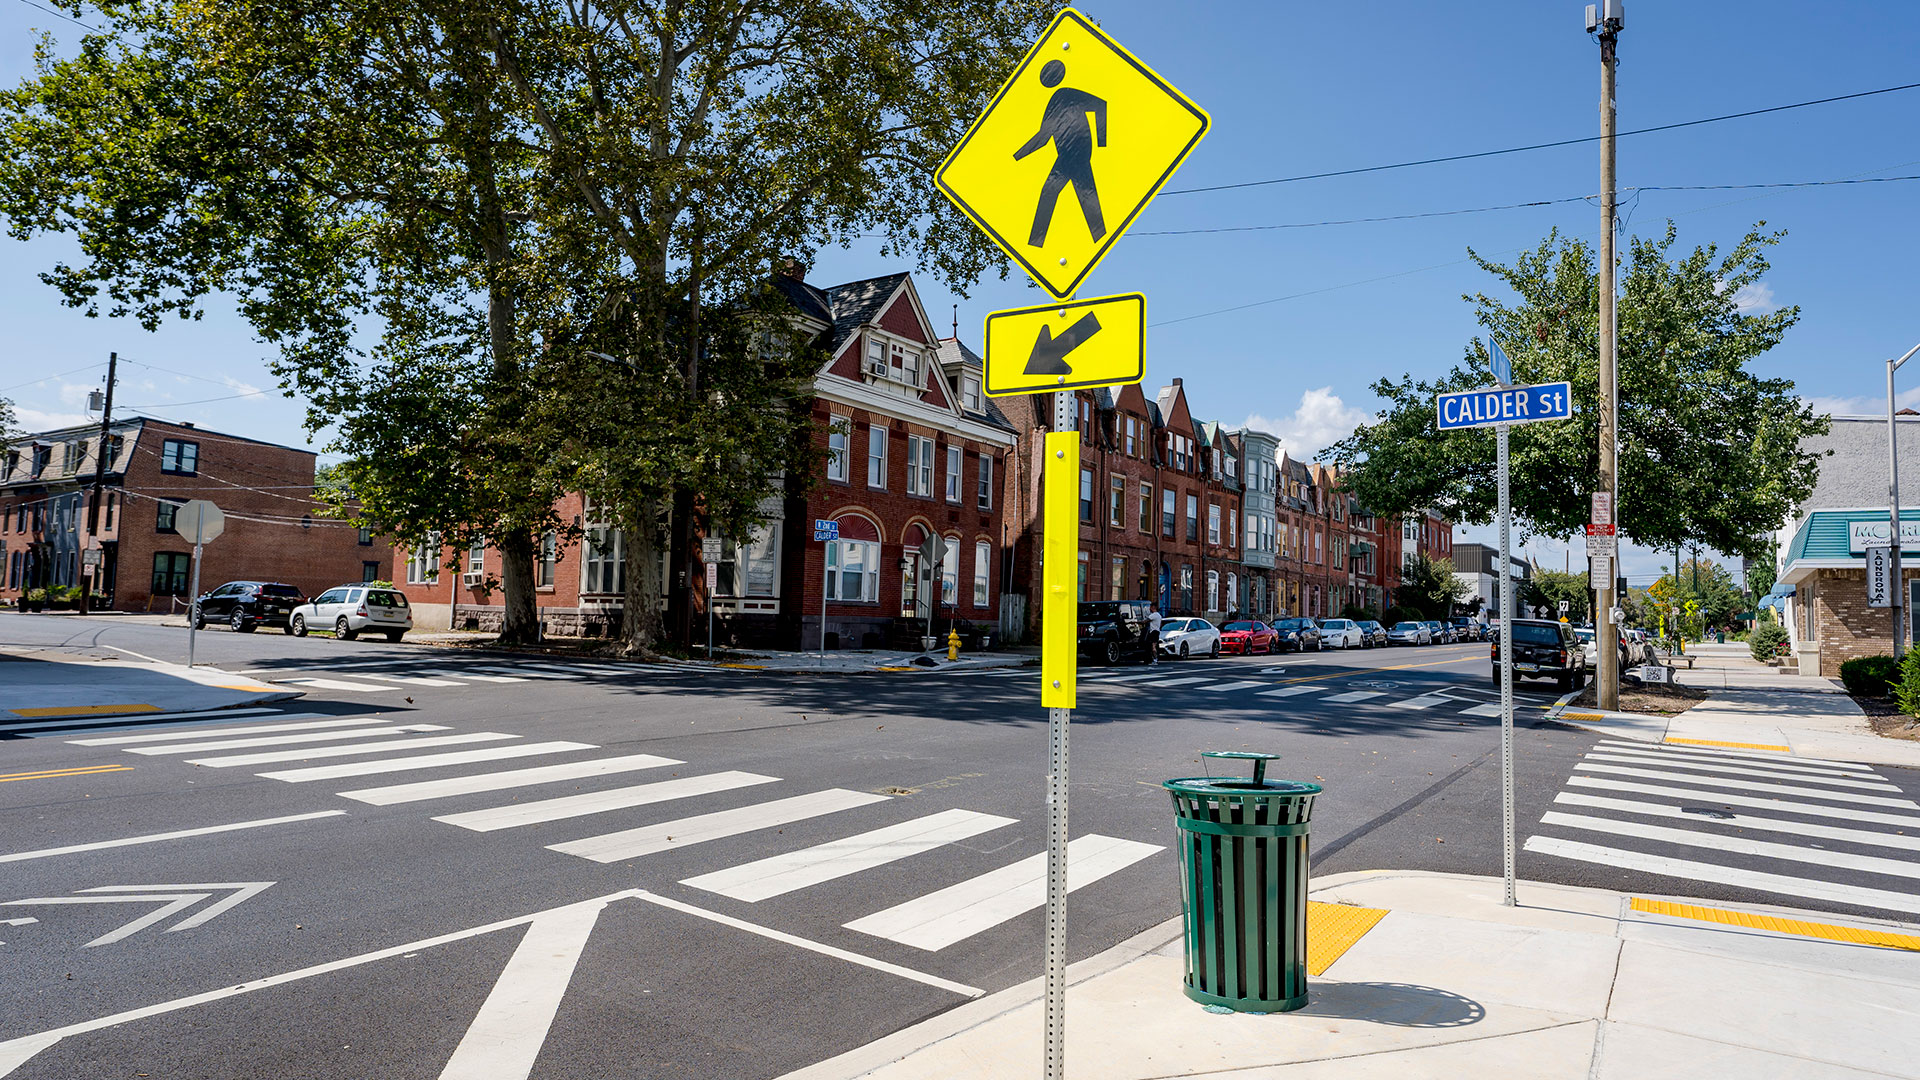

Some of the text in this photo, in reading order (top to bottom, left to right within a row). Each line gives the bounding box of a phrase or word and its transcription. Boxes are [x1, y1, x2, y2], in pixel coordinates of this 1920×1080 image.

[1444, 391, 1563, 423] CALDER St
[1874, 550, 1885, 604] LAUNDROMAT
